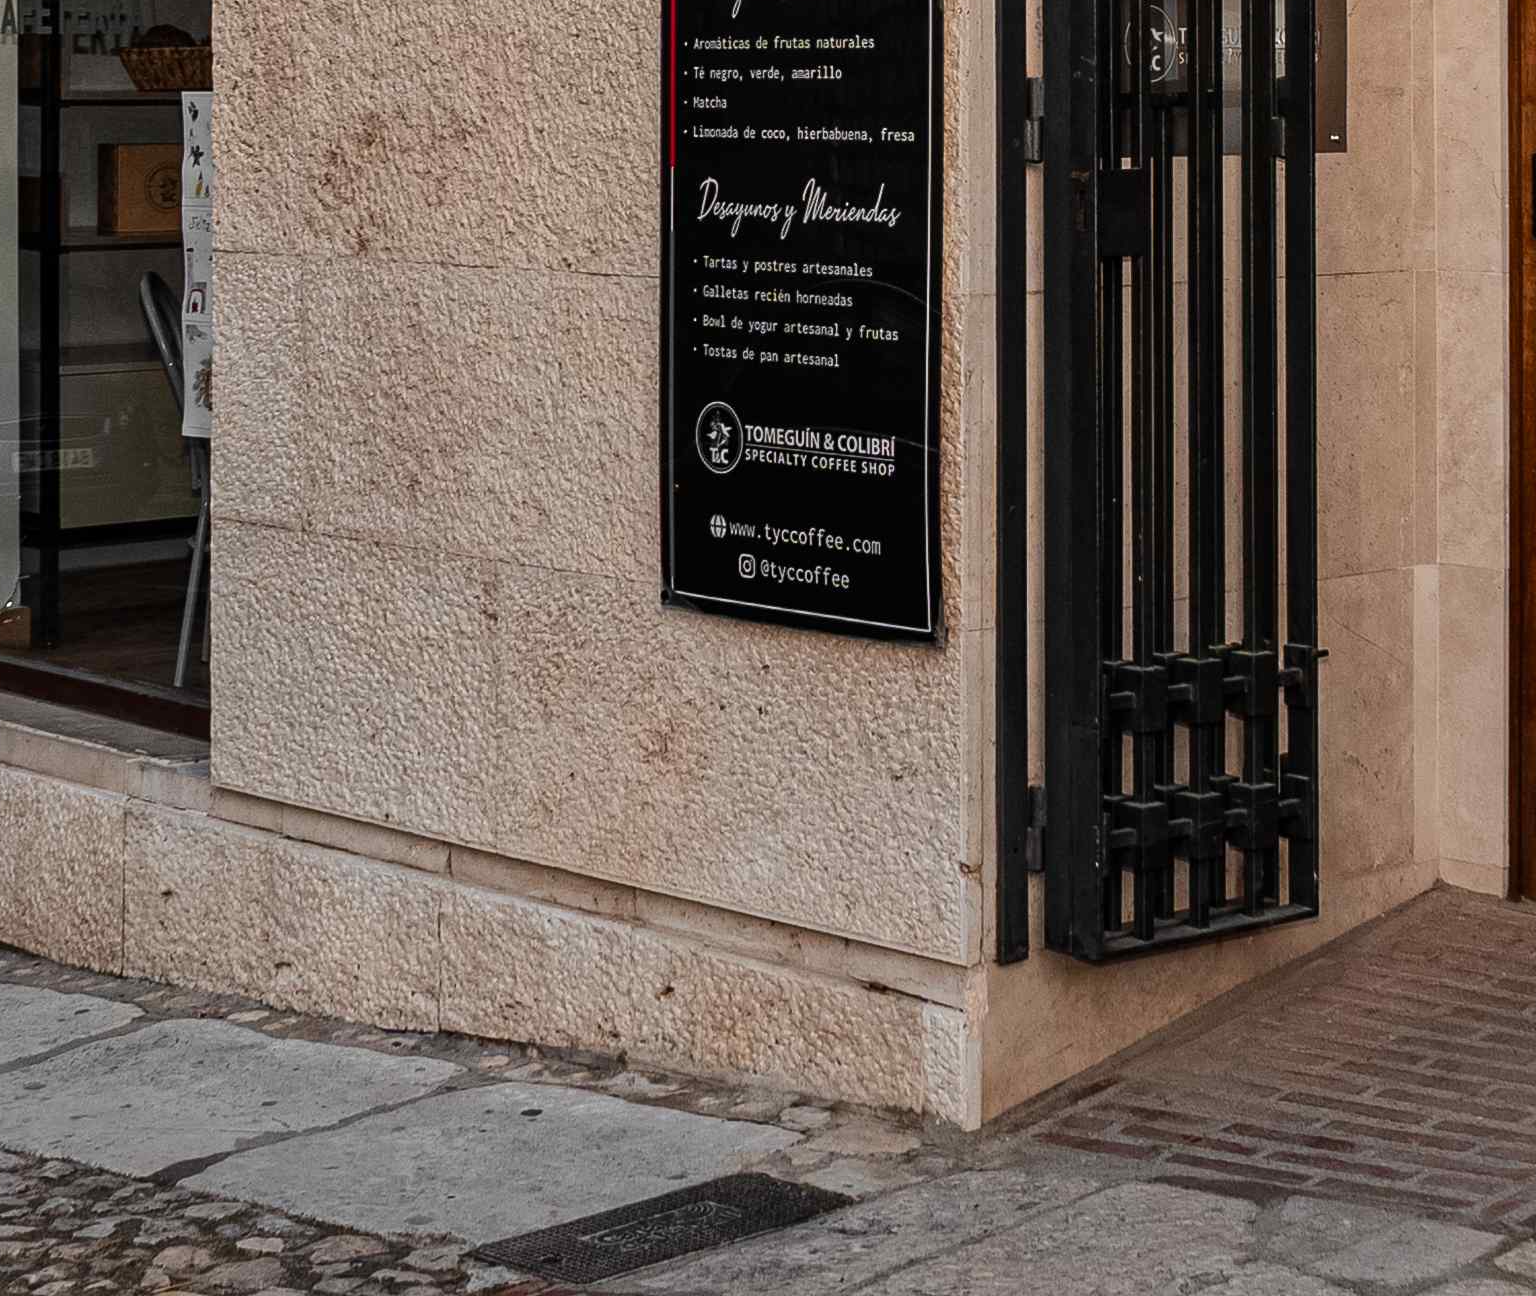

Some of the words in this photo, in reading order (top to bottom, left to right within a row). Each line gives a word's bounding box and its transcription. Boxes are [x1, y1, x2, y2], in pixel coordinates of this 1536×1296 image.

[693, 37, 750, 49] Aromáticas
[755, 36, 768, 49] de
[774, 36, 811, 49] frutas
[816, 35, 875, 48] naturales
[693, 67, 705, 79] Té
[710, 68, 743, 82] negro,
[750, 66, 784, 82] verde,
[792, 65, 842, 79] amarillo
[693, 96, 727, 109] Matcha
[693, 125, 738, 139] Limonada
[743, 126, 756, 139] de
[761, 128, 790, 142] coco,
[797, 126, 873, 143] hierbabuena,
[881, 128, 915, 142] fresa
[697, 176, 783, 238] Desayunos
[781, 204, 798, 240] y
[802, 178, 901, 227] Meriendas
[703, 256, 737, 269] Tartas
[742, 260, 749, 273] y
[754, 259, 797, 273] postres
[802, 263, 873, 277] artesanales
[703, 285, 749, 300] Galletas
[754, 289, 791, 303] recién
[796, 290, 853, 307] horneadas
[703, 315, 726, 328] Bowl
[731, 316, 743, 329] de
[748, 320, 778, 334] yogur
[784, 323, 840, 337] artesanal
[845, 326, 853, 341] y
[860, 325, 899, 341] frutas
[703, 344, 737, 359] Tostas
[742, 347, 755, 360] de
[760, 351, 778, 363] pan
[784, 354, 840, 367] artesanal
[745, 425, 820, 449] TOMEGUÍN
[823, 433, 834, 450] &
[838, 435, 896, 457] COLIBRÍ
[745, 448, 807, 467] SPECIALTY
[811, 455, 857, 473] COFFEE
[861, 461, 895, 477] SHOP
[729, 521, 881, 555] www.tyccoffee.com
[760, 559, 850, 589] @tyccoffee
